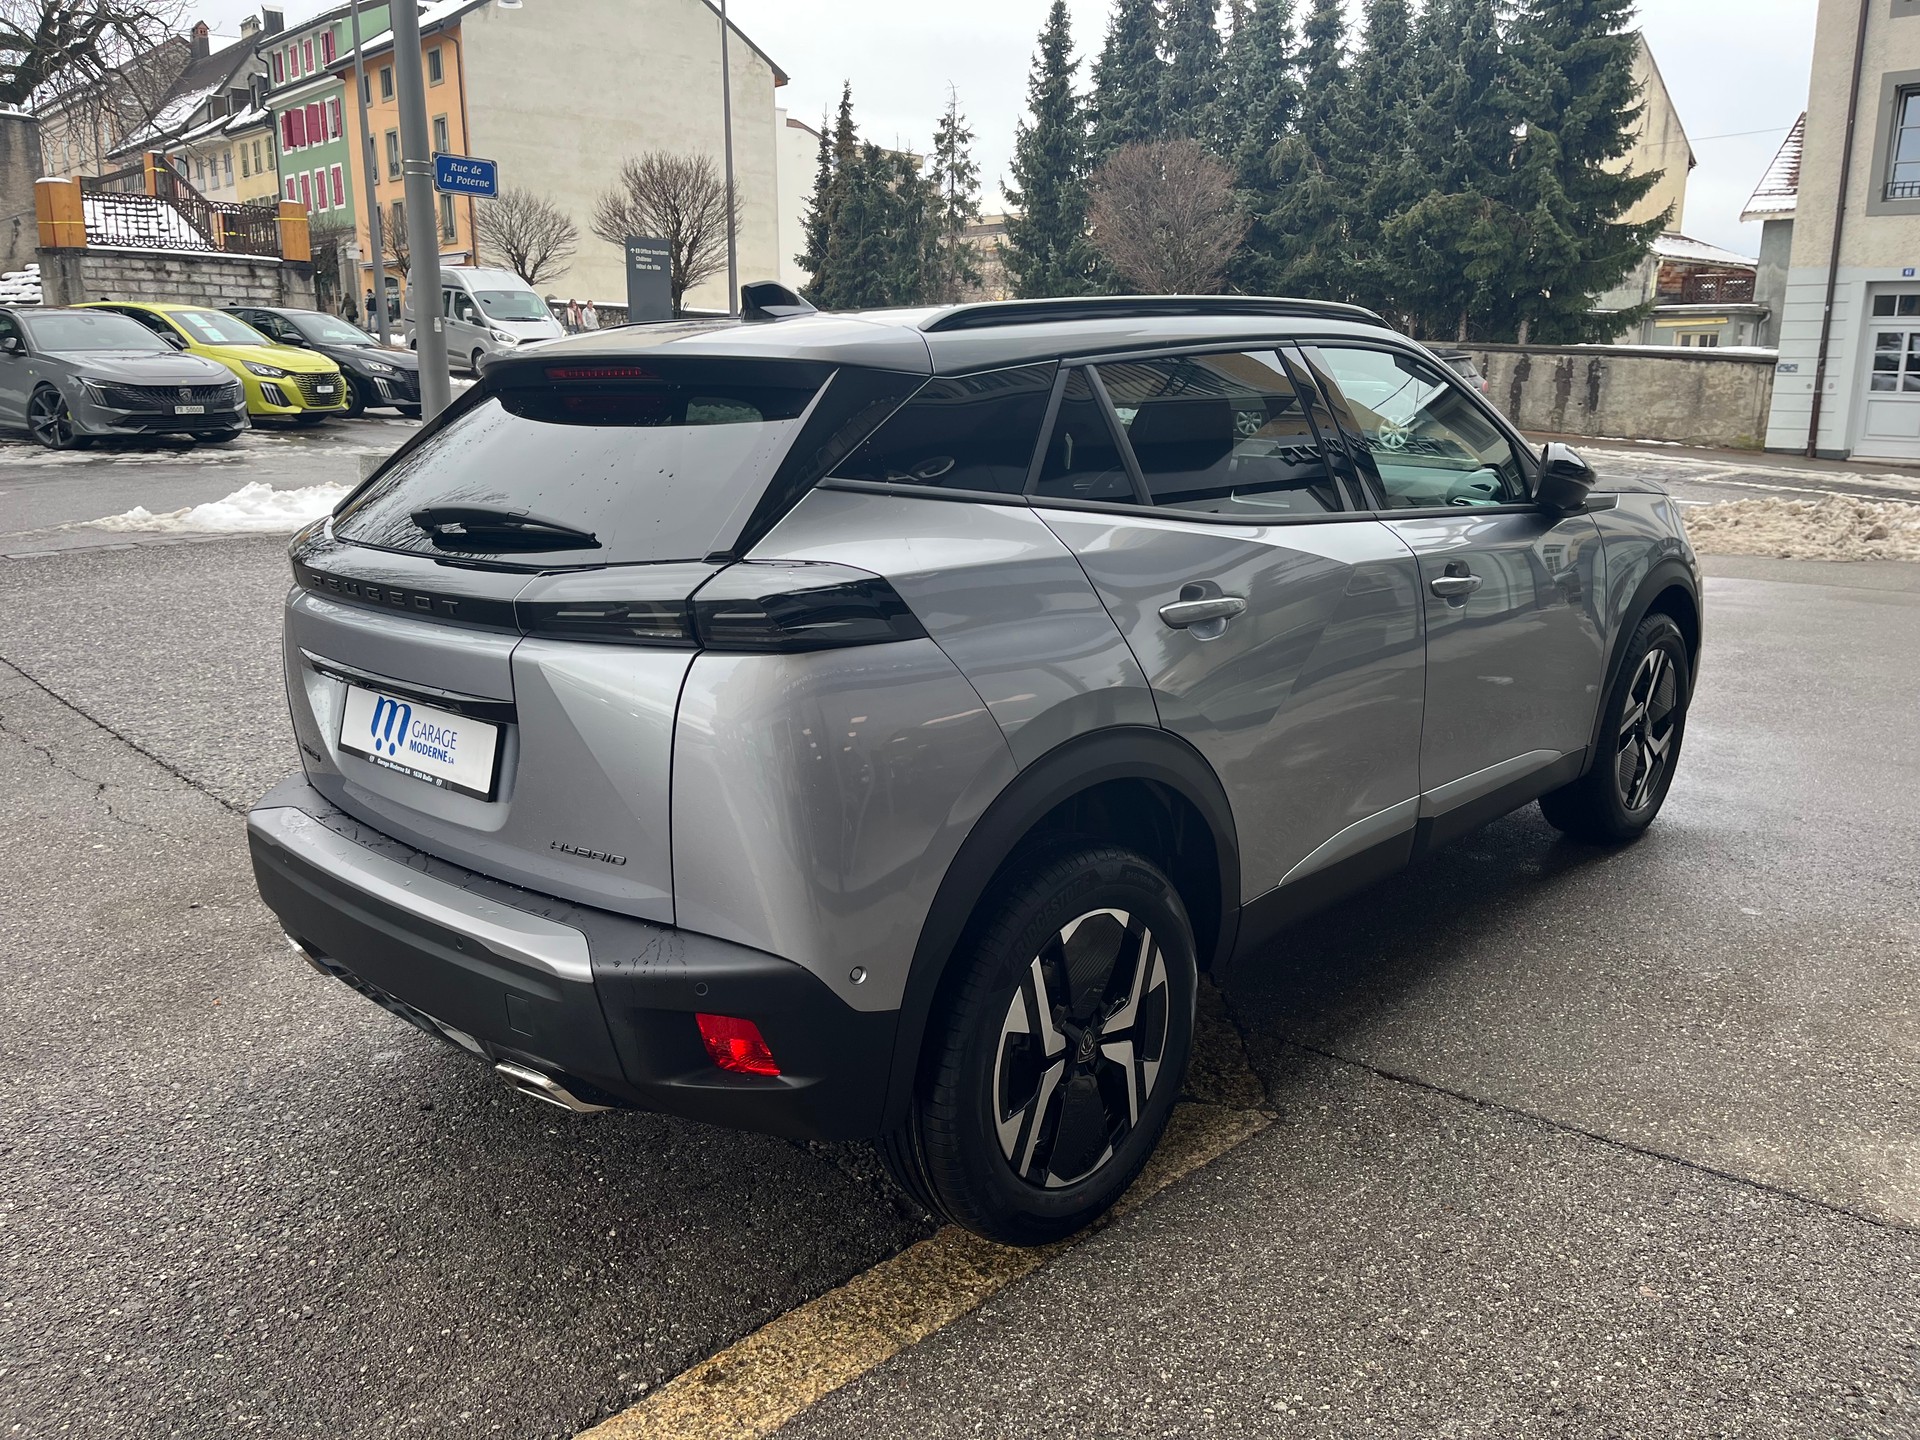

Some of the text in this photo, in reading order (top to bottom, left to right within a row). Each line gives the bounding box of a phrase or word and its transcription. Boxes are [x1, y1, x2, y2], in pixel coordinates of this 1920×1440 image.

[443, 173, 490, 188] la Poterne
[450, 163, 482, 175] Rue de
[311, 574, 459, 615] PEUGEOT
[411, 720, 458, 750] GARAGE
[409, 739, 448, 763] MODERNE
[377, 757, 389, 768] Garage
[389, 762, 405, 773] Moderne
[405, 767, 411, 775] SA
[550, 840, 627, 866] HYBRID
